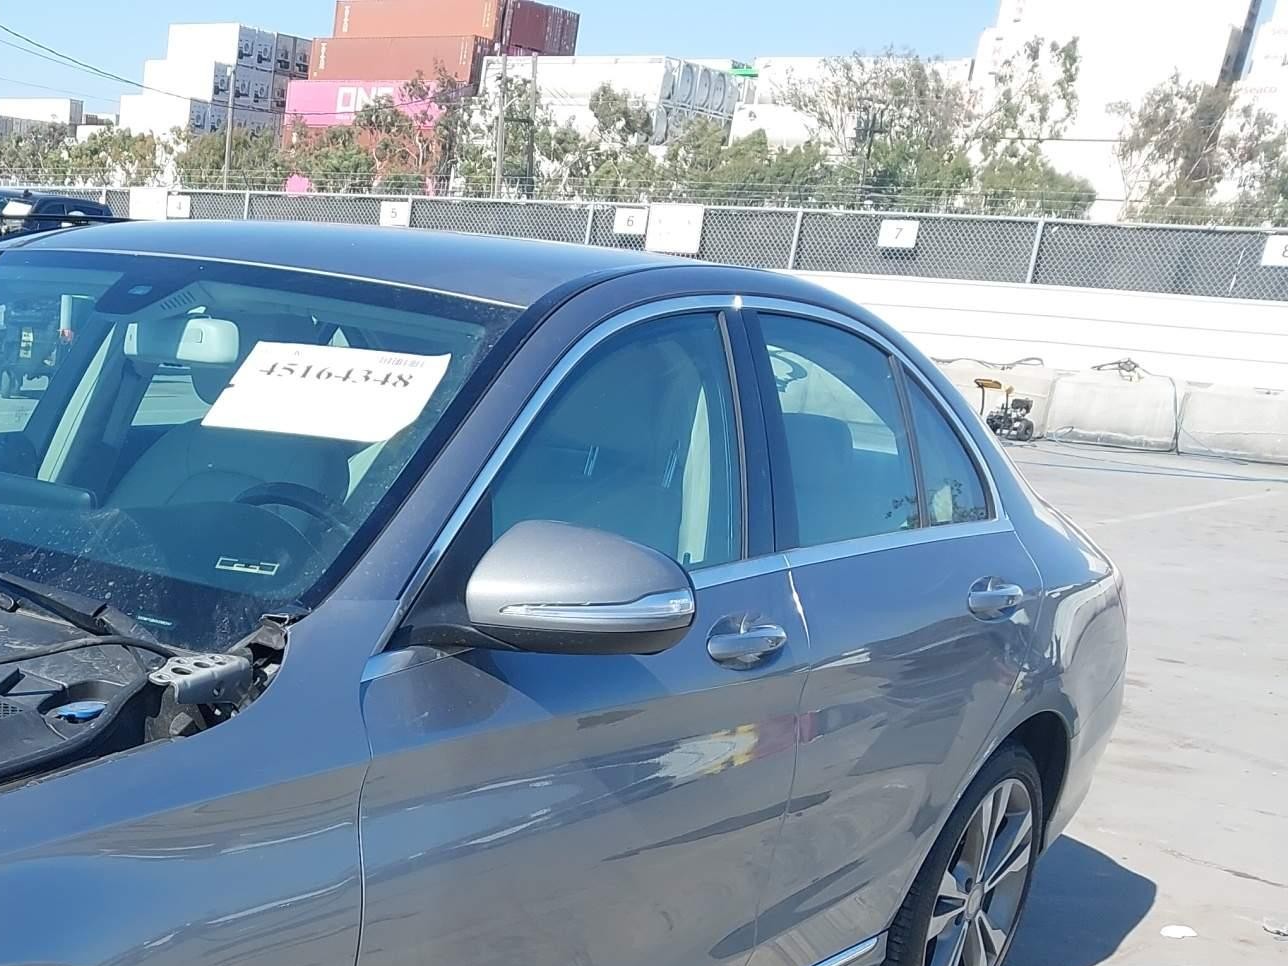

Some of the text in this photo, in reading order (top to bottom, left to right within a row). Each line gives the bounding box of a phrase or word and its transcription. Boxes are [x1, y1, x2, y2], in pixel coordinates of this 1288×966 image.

[390, 208, 398, 219] 5
[626, 215, 635, 228] 6
[894, 227, 904, 240] 7
[259, 362, 414, 388] 45164348
